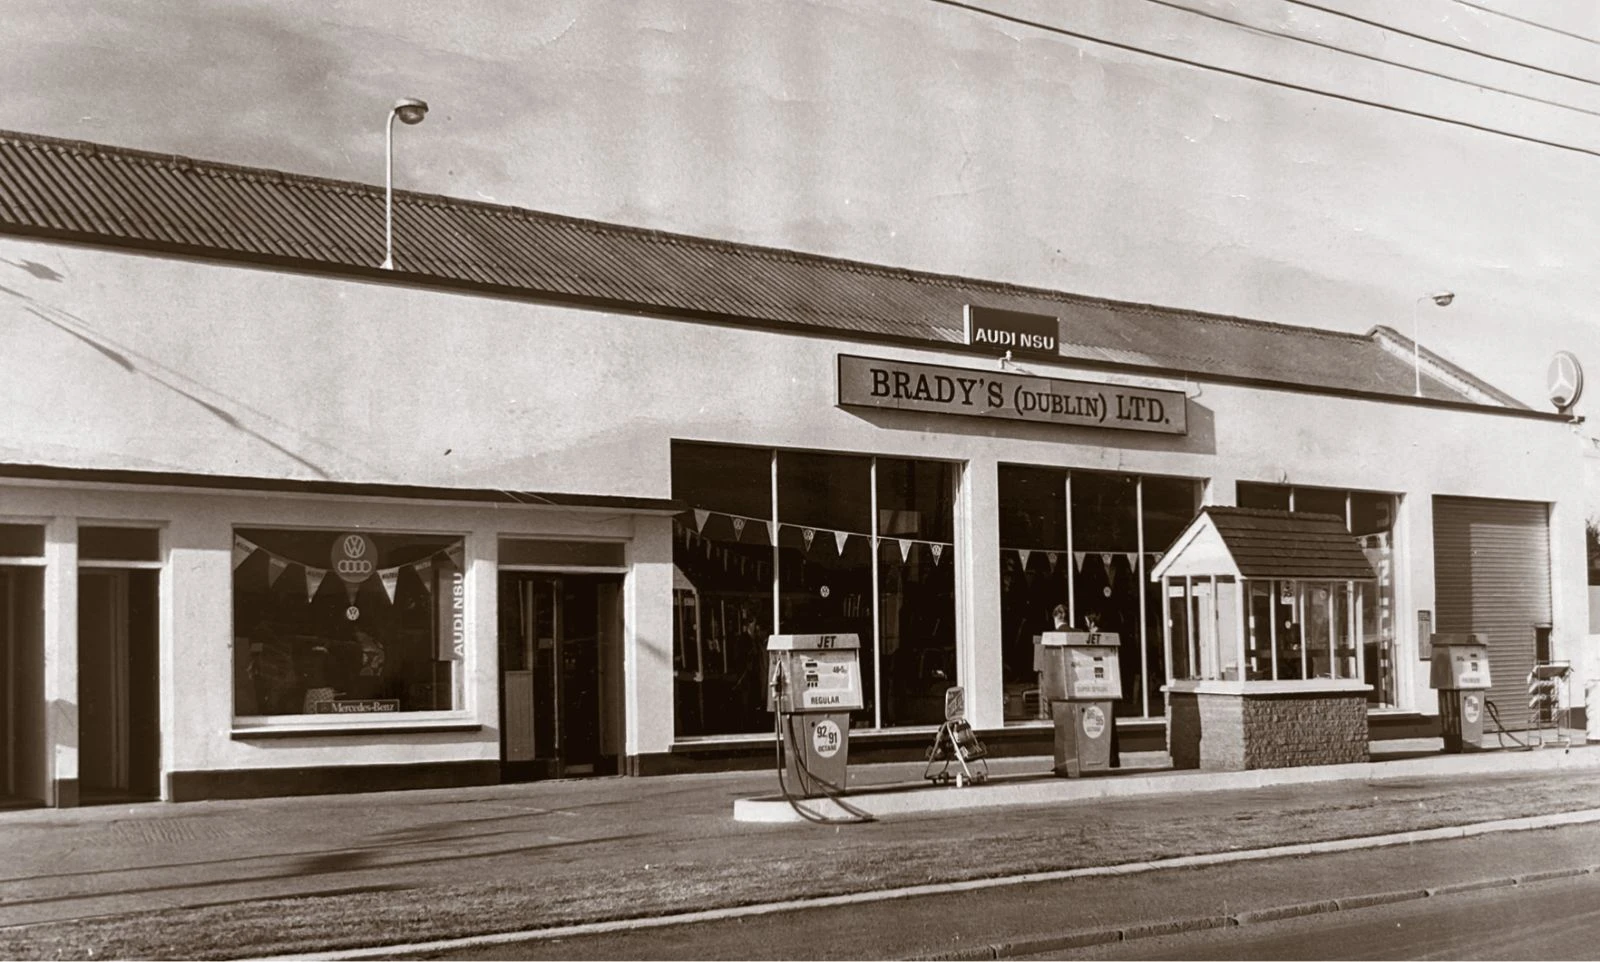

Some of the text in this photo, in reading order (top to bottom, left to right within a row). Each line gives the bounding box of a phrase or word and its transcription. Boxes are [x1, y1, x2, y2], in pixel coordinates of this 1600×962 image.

[975, 327, 1054, 350] AUDI NSU
[870, 368, 1170, 425] BRADY'S (DUBLIN) LTD.
[453, 572, 464, 657] AUDI NSU
[817, 636, 837, 648] JET
[1086, 633, 1102, 644] JET
[810, 696, 840, 705] REGULAR
[331, 702, 394, 712] Mercedes-Benz
[816, 725, 828, 738] 92
[828, 732, 838, 744] 91
